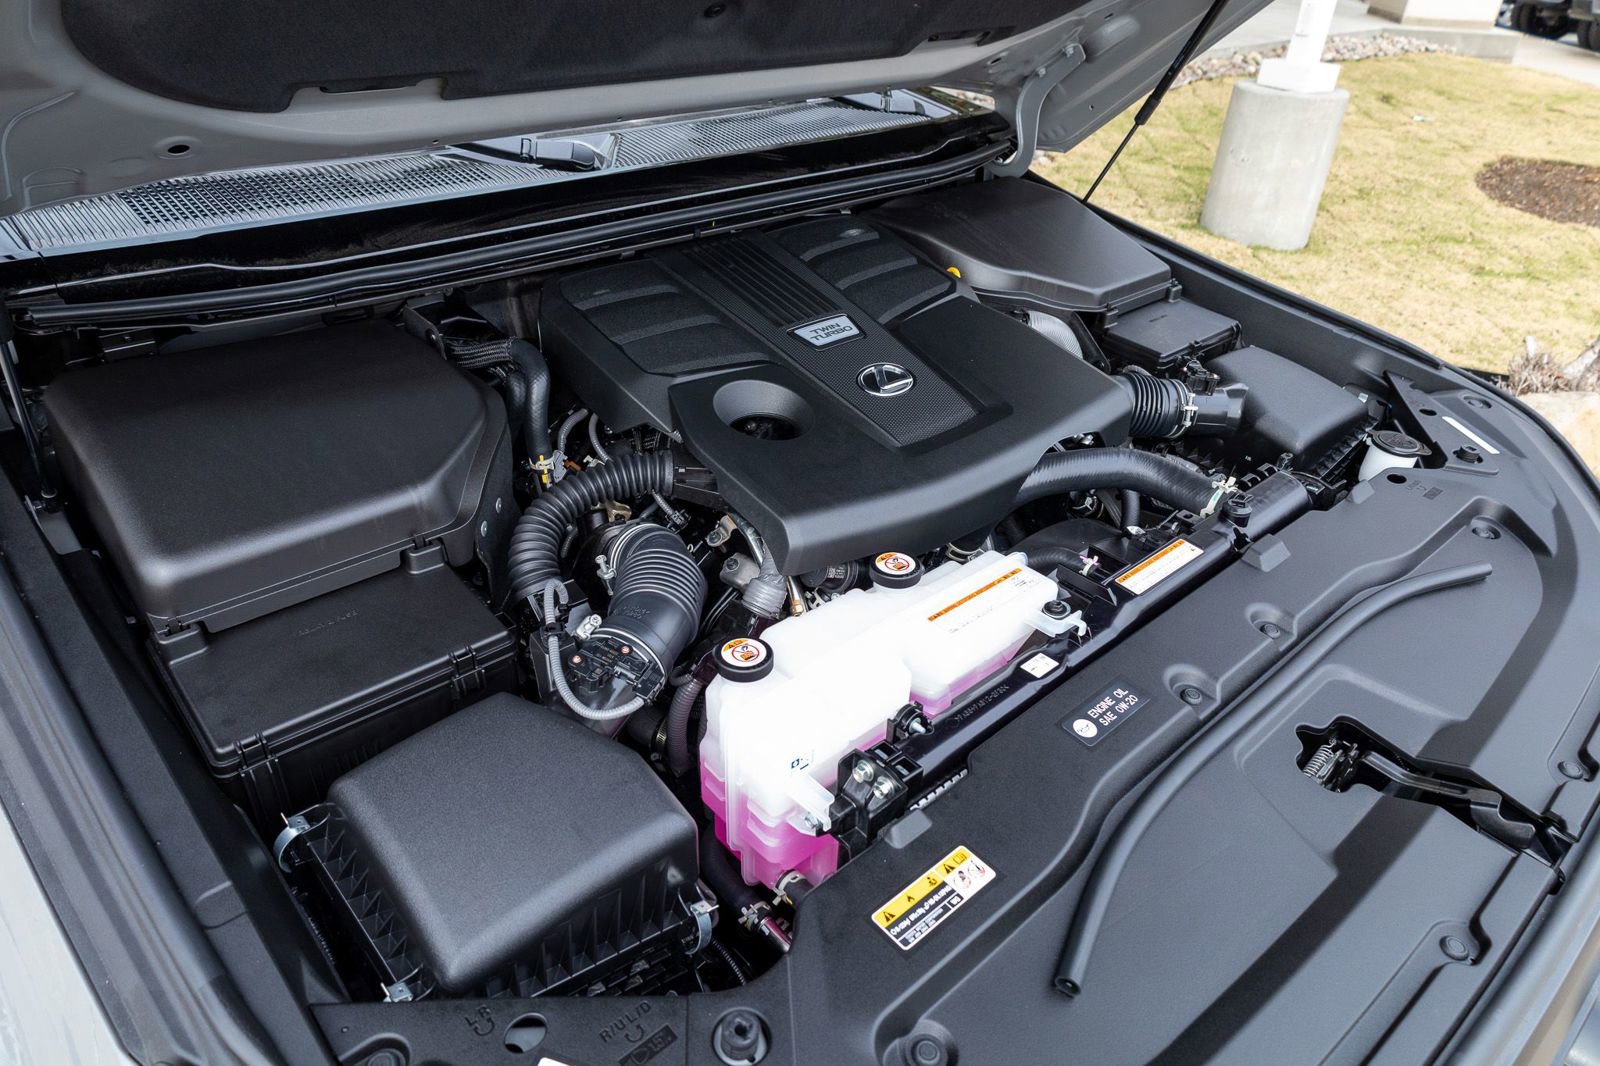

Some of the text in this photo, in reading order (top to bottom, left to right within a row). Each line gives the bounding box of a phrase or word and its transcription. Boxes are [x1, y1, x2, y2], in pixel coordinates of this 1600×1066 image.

[810, 323, 840, 334] TWIN
[811, 325, 853, 341] TURBO
[1087, 688, 1129, 719] ENGINE OIL
[1099, 694, 1138, 726] SAE 0W-20
